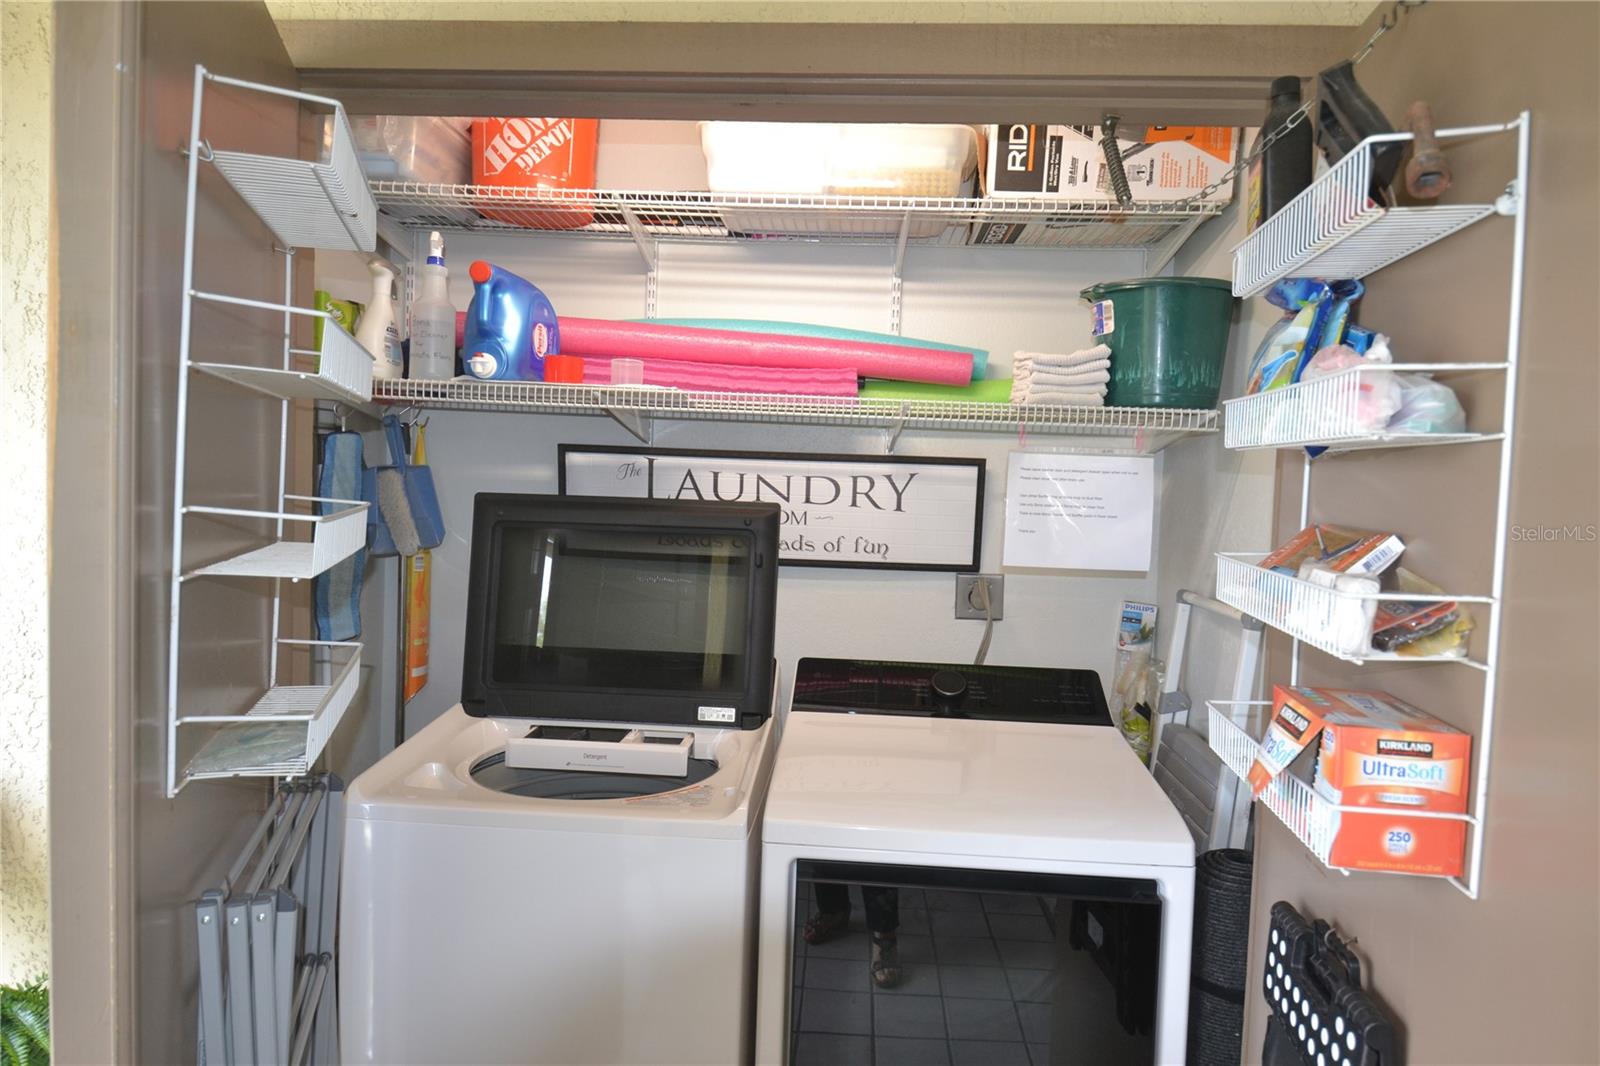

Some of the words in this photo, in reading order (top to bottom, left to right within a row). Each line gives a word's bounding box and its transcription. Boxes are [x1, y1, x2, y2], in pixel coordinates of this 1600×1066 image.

[514, 119, 573, 172] DEPOT
[616, 463, 641, 480] The
[646, 456, 919, 512] LAUNDRY
[779, 510, 808, 526] OM
[778, 534, 815, 552] ads
[823, 536, 845, 553] of
[854, 536, 889, 560] fun
[1124, 603, 1155, 613] PHILIPS
[1379, 740, 1432, 752] KIRKLAND
[583, 752, 607, 761] Detergent
[1363, 760, 1444, 781] UltraSoft
[1388, 831, 1411, 843] 250
